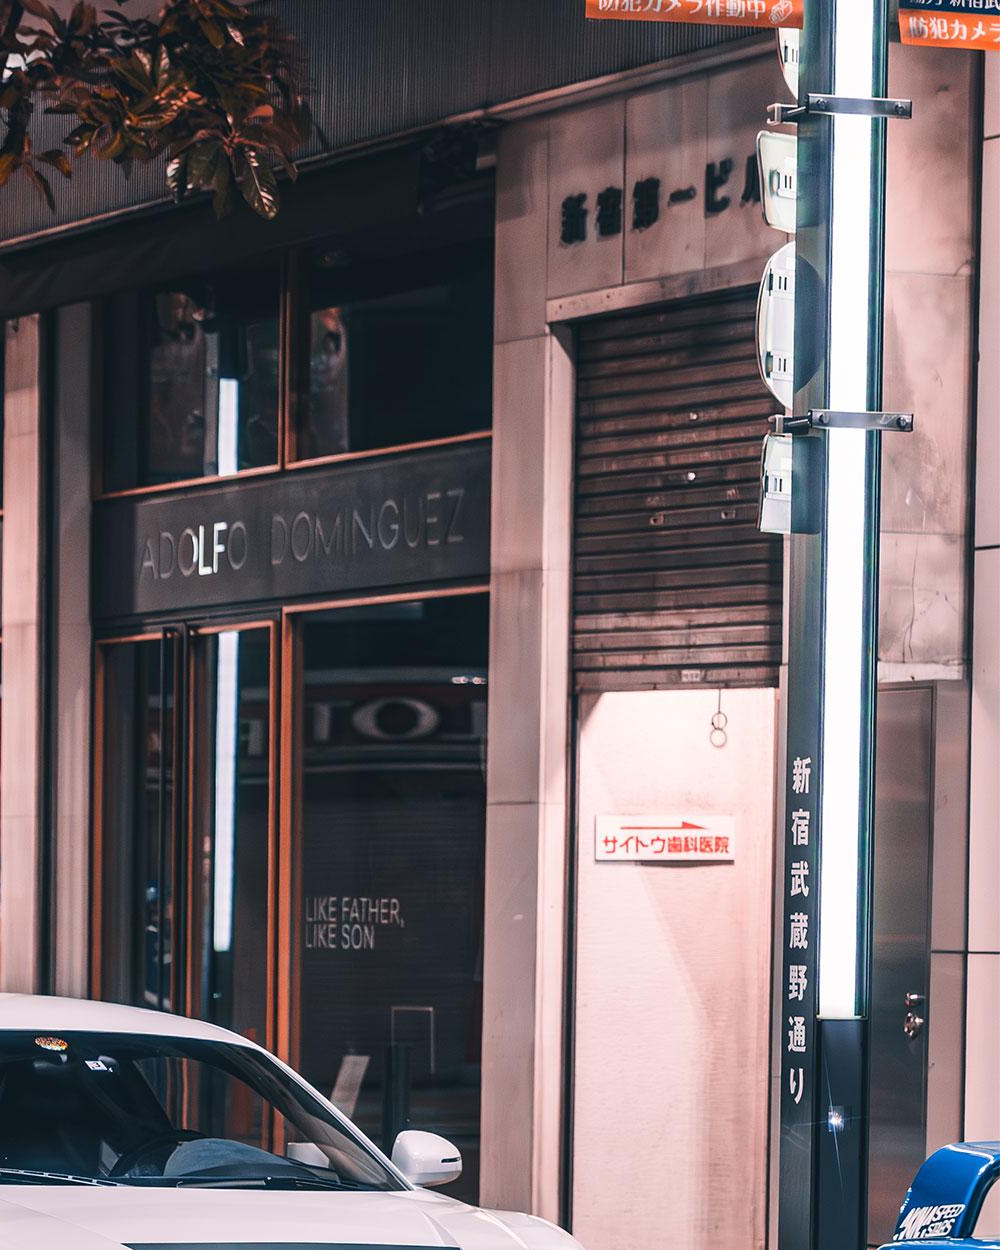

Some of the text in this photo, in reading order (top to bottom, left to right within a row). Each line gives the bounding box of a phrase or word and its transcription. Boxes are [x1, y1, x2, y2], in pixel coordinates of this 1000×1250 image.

[139, 488, 465, 579] ADOLFO DOMINGUEZ
[603, 836, 730, 854] サイトウ歯科医院
[305, 897, 337, 922] LIKE
[305, 923, 375, 950] LIKE SON
[787, 757, 812, 1105] 新宿武蔵野通り
